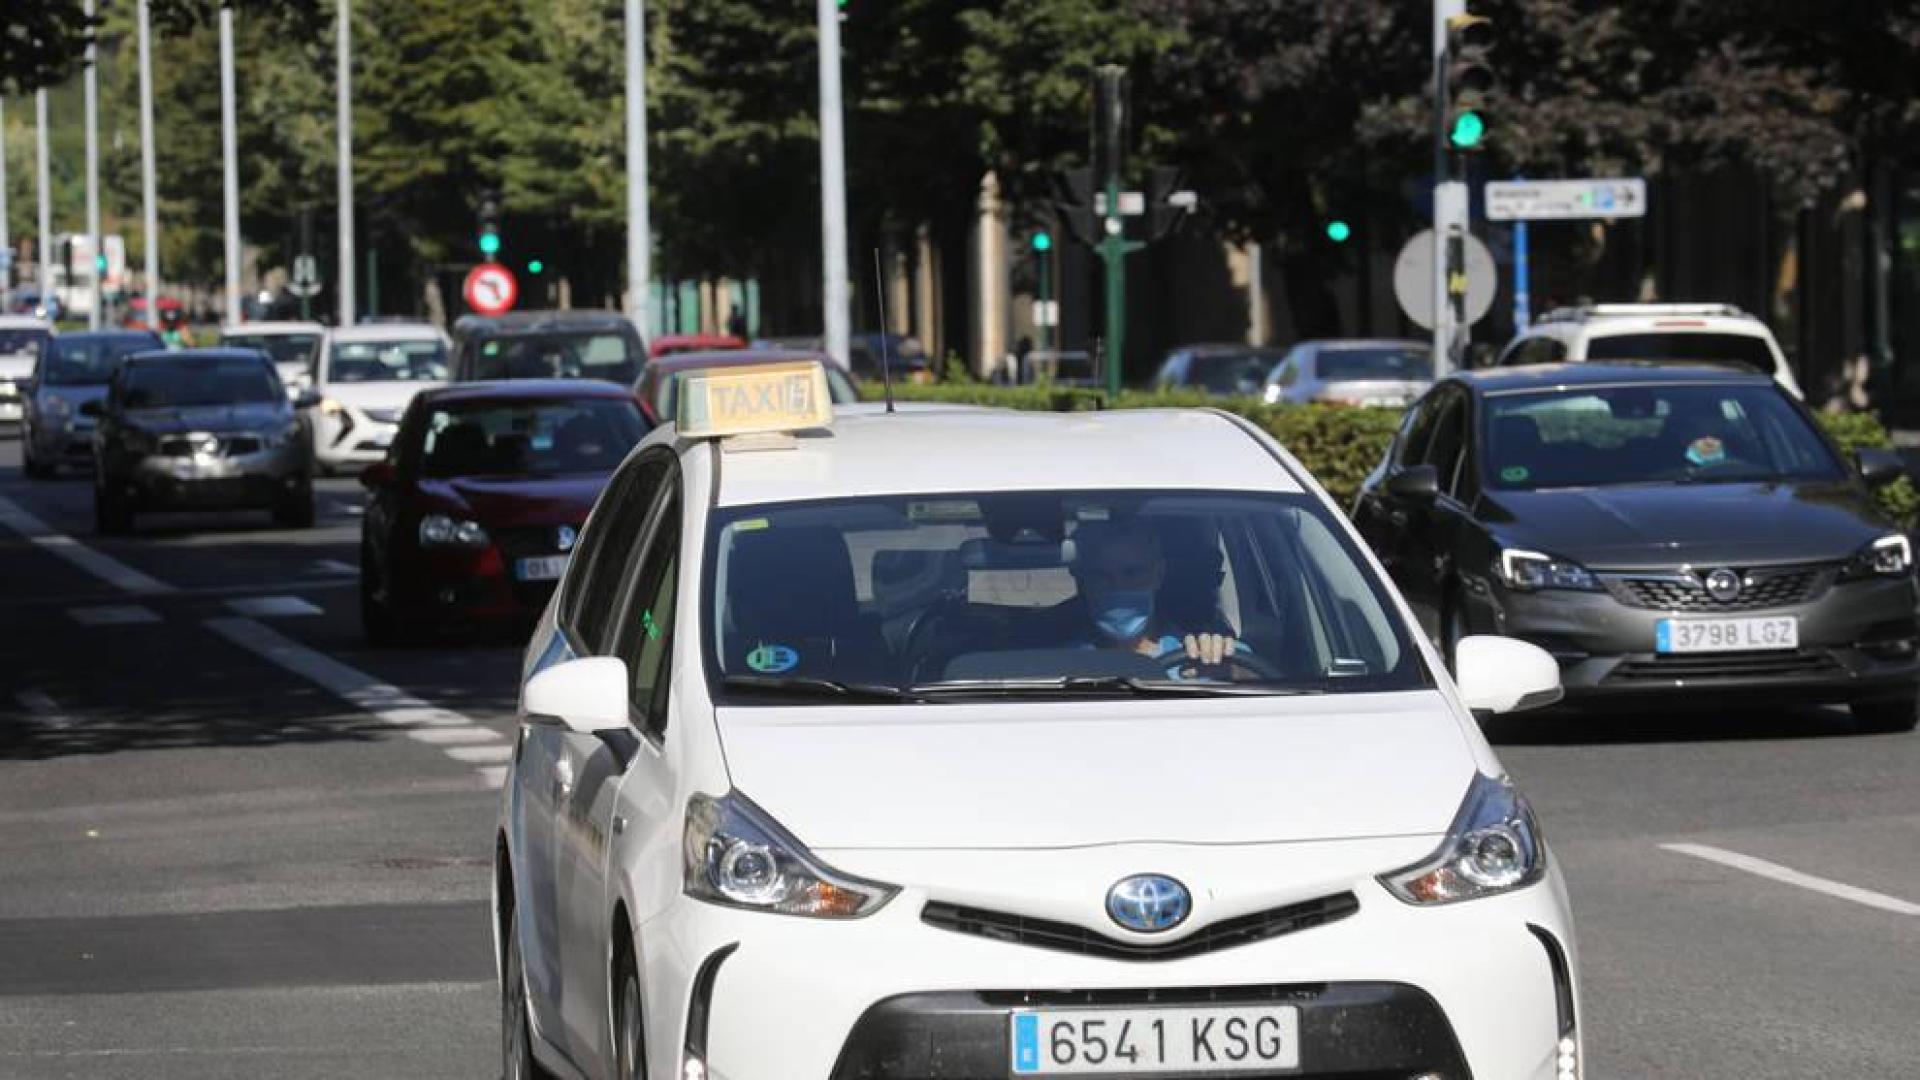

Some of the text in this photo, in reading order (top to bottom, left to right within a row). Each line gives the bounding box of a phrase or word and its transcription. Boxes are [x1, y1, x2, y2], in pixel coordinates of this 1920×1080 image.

[712, 384, 783, 416] TAXI
[1677, 620, 1793, 647] 3798 LGZ
[1051, 1015, 1282, 1065] 6541 KSG
